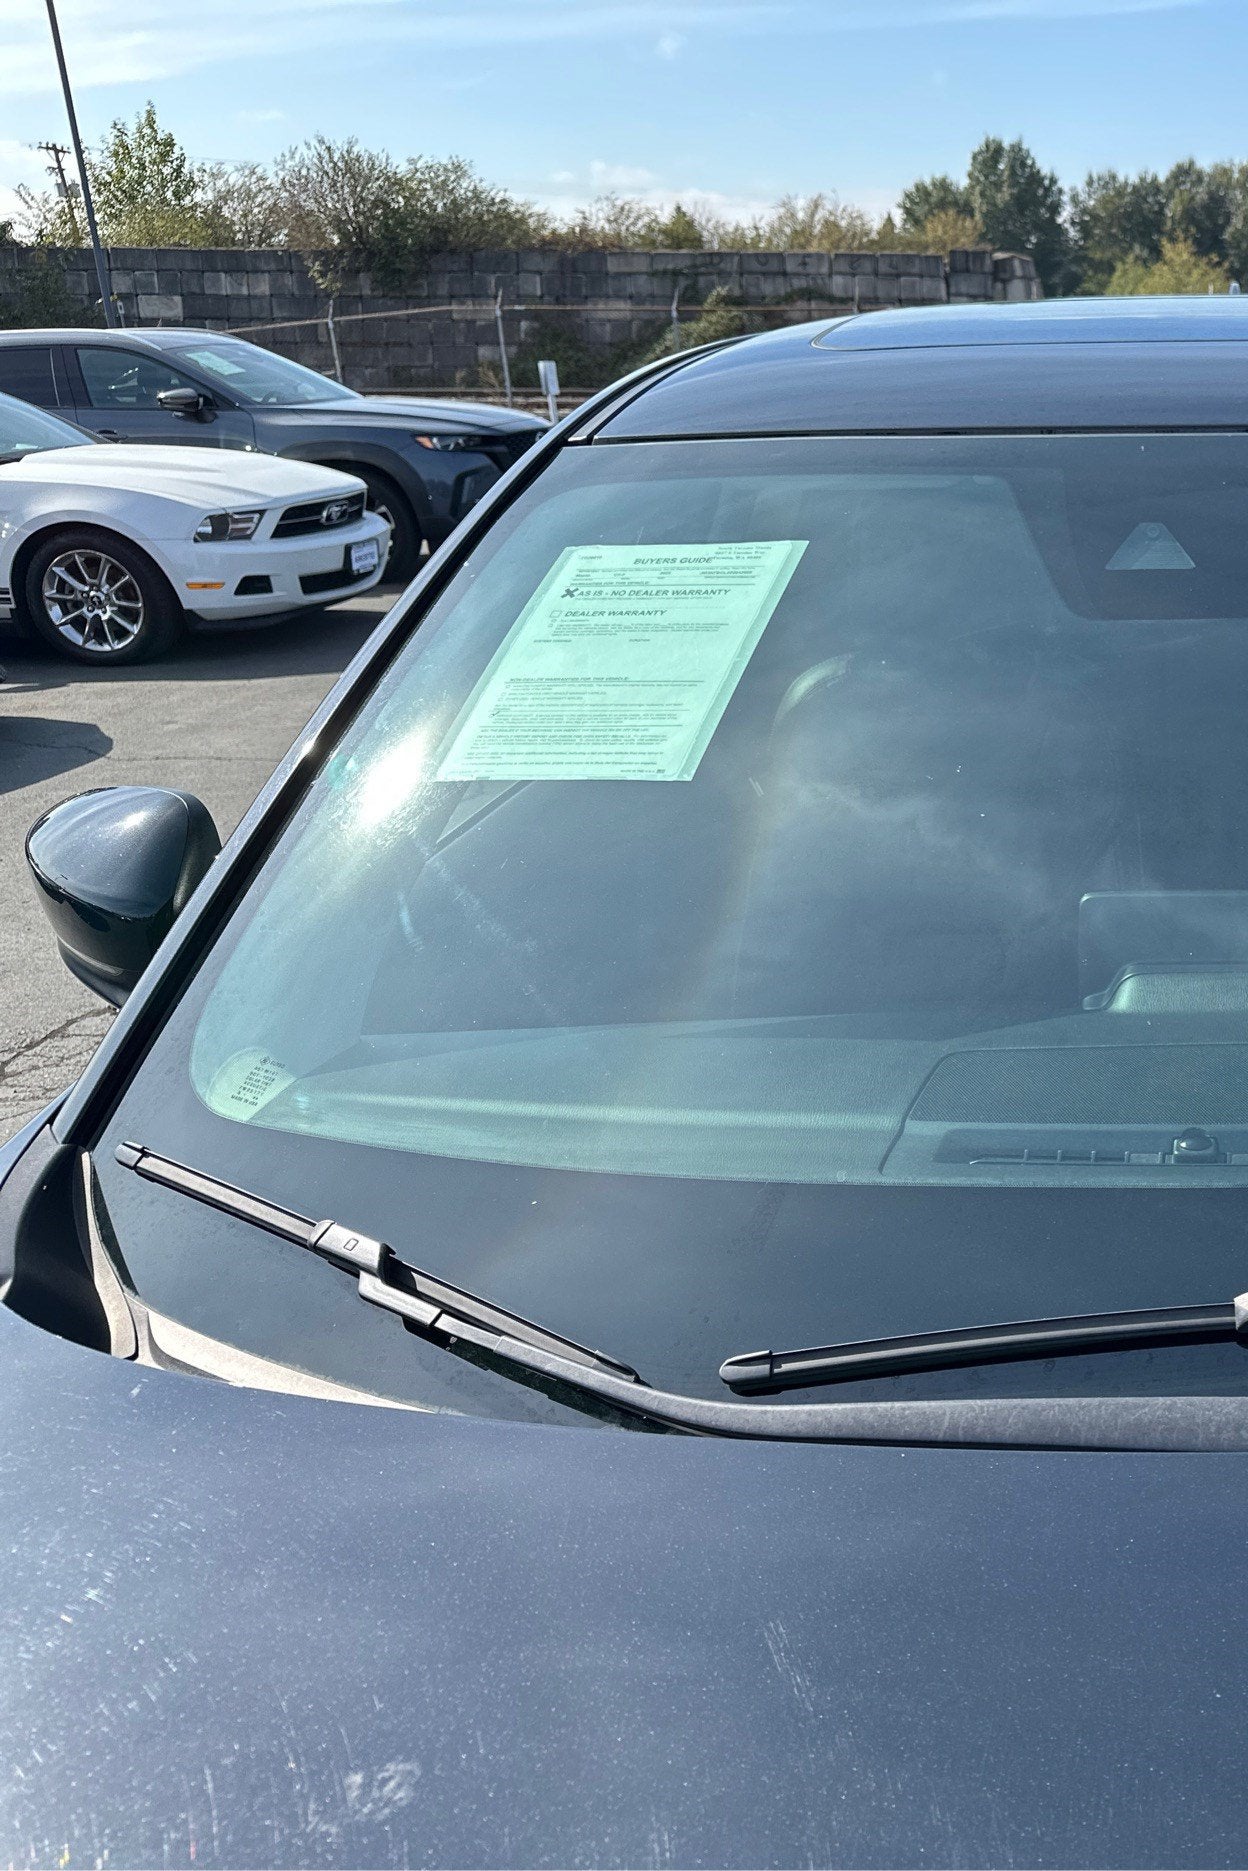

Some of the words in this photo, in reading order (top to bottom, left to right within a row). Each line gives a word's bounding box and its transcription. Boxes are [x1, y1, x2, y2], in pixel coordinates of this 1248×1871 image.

[633, 557, 677, 565] BUYERS
[679, 556, 713, 564] GUIDE
[610, 589, 626, 597] NO
[628, 589, 669, 597] DEALER
[671, 588, 732, 596] WARRANTY
[564, 610, 606, 618] DEALER
[607, 609, 668, 617] WARRANTY
[231, 1094, 243, 1102] MADE
